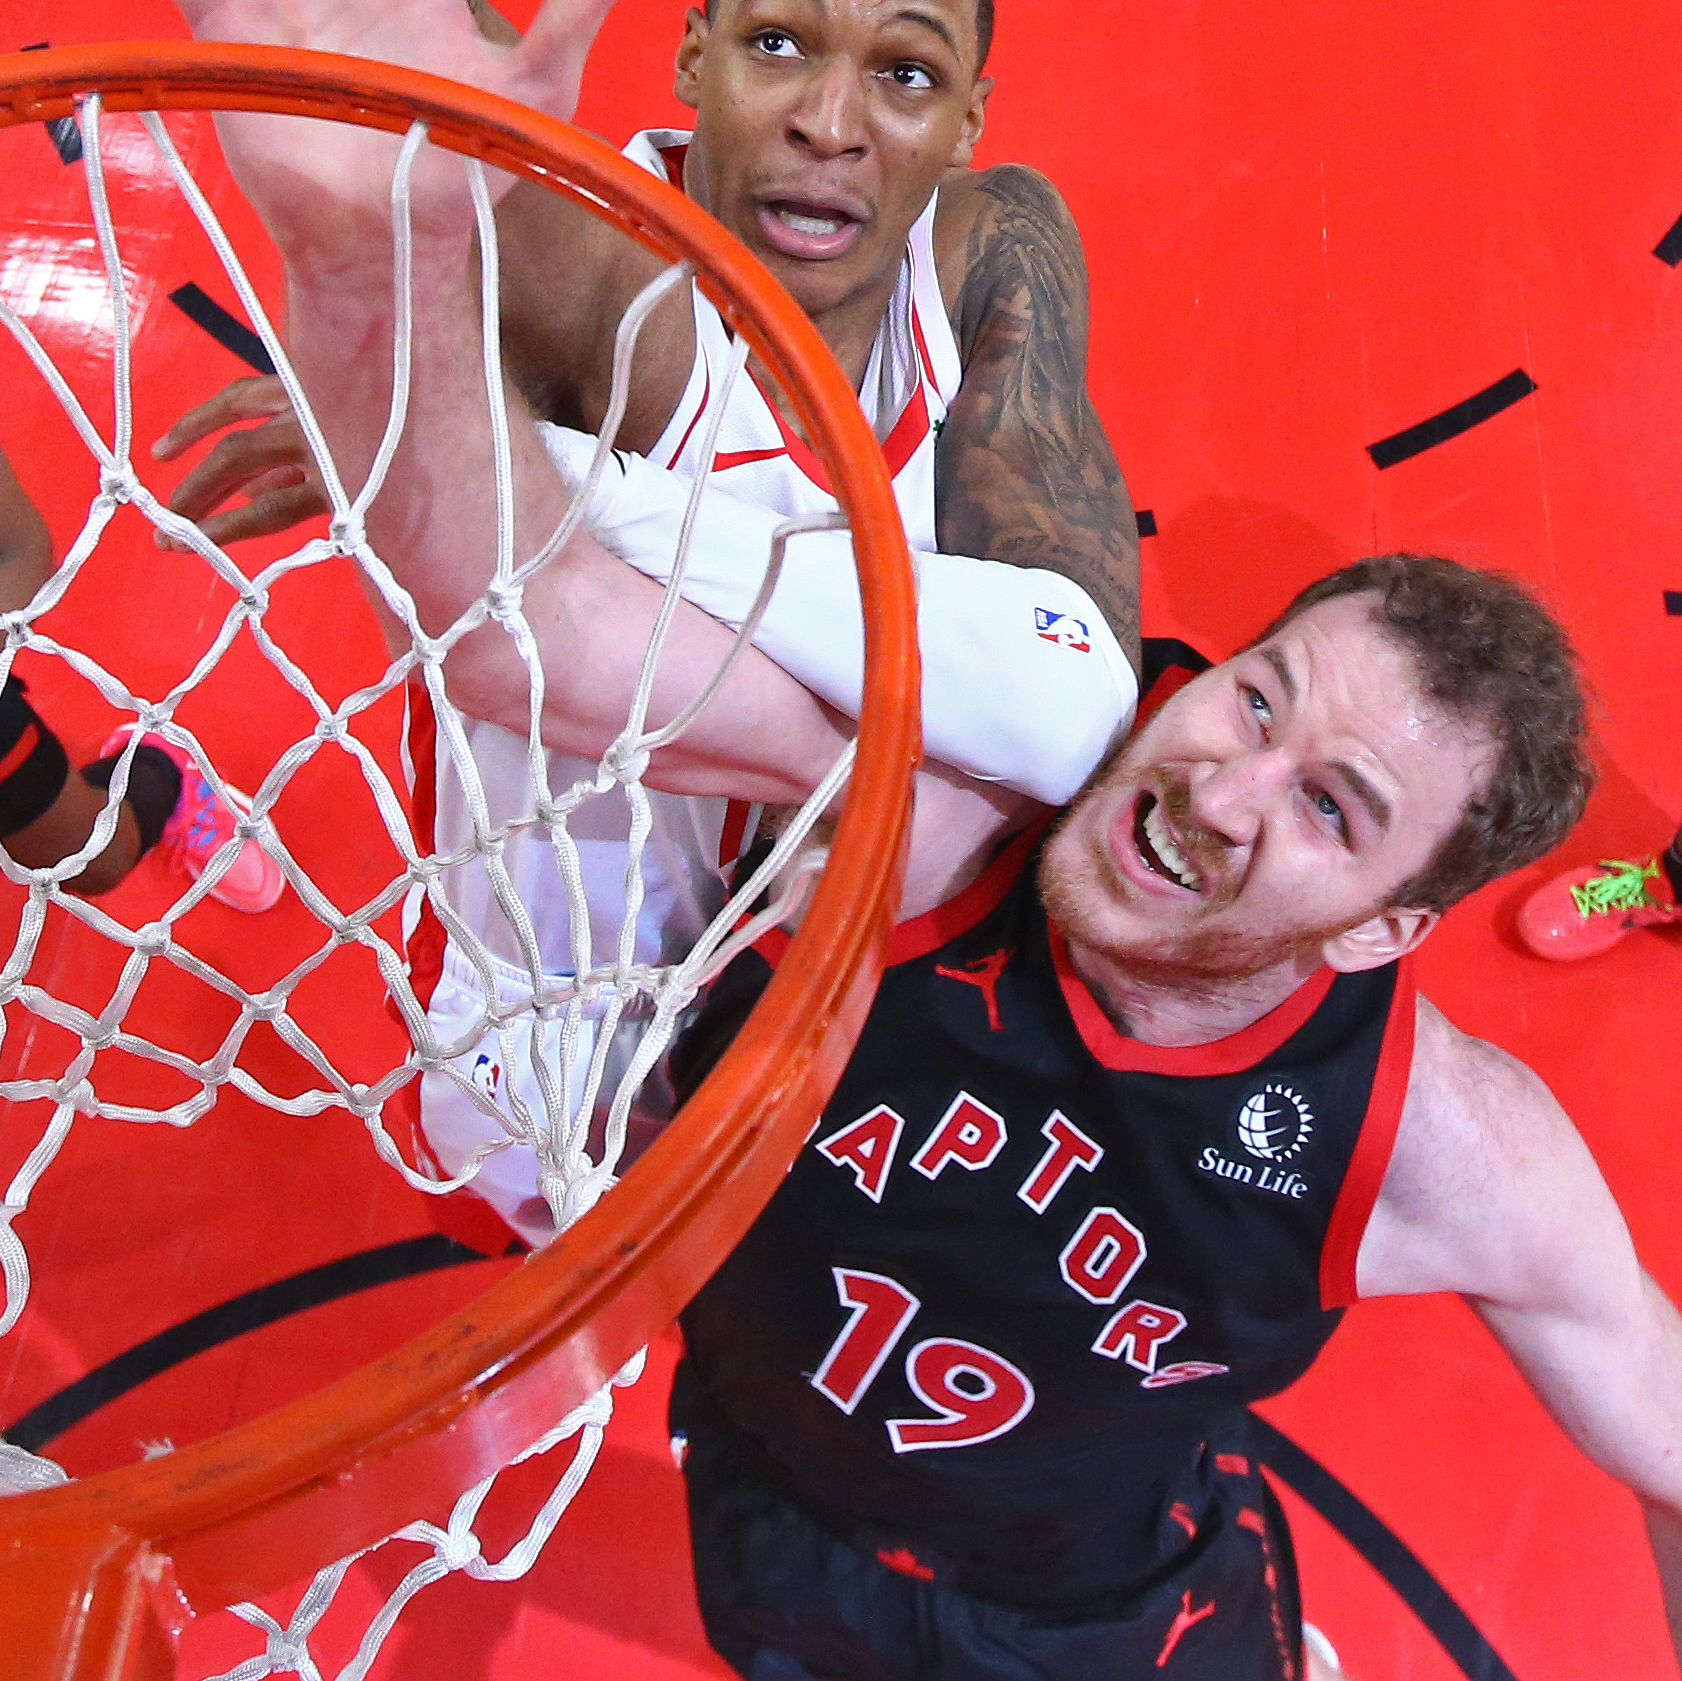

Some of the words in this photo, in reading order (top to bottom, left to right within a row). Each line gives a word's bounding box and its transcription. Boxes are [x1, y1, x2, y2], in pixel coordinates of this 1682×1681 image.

[791, 1090, 1230, 1389] APTORS
[1197, 1146, 1254, 1184] Sun
[1256, 1166, 1309, 1199] Life
[810, 1267, 1036, 1454] 19
